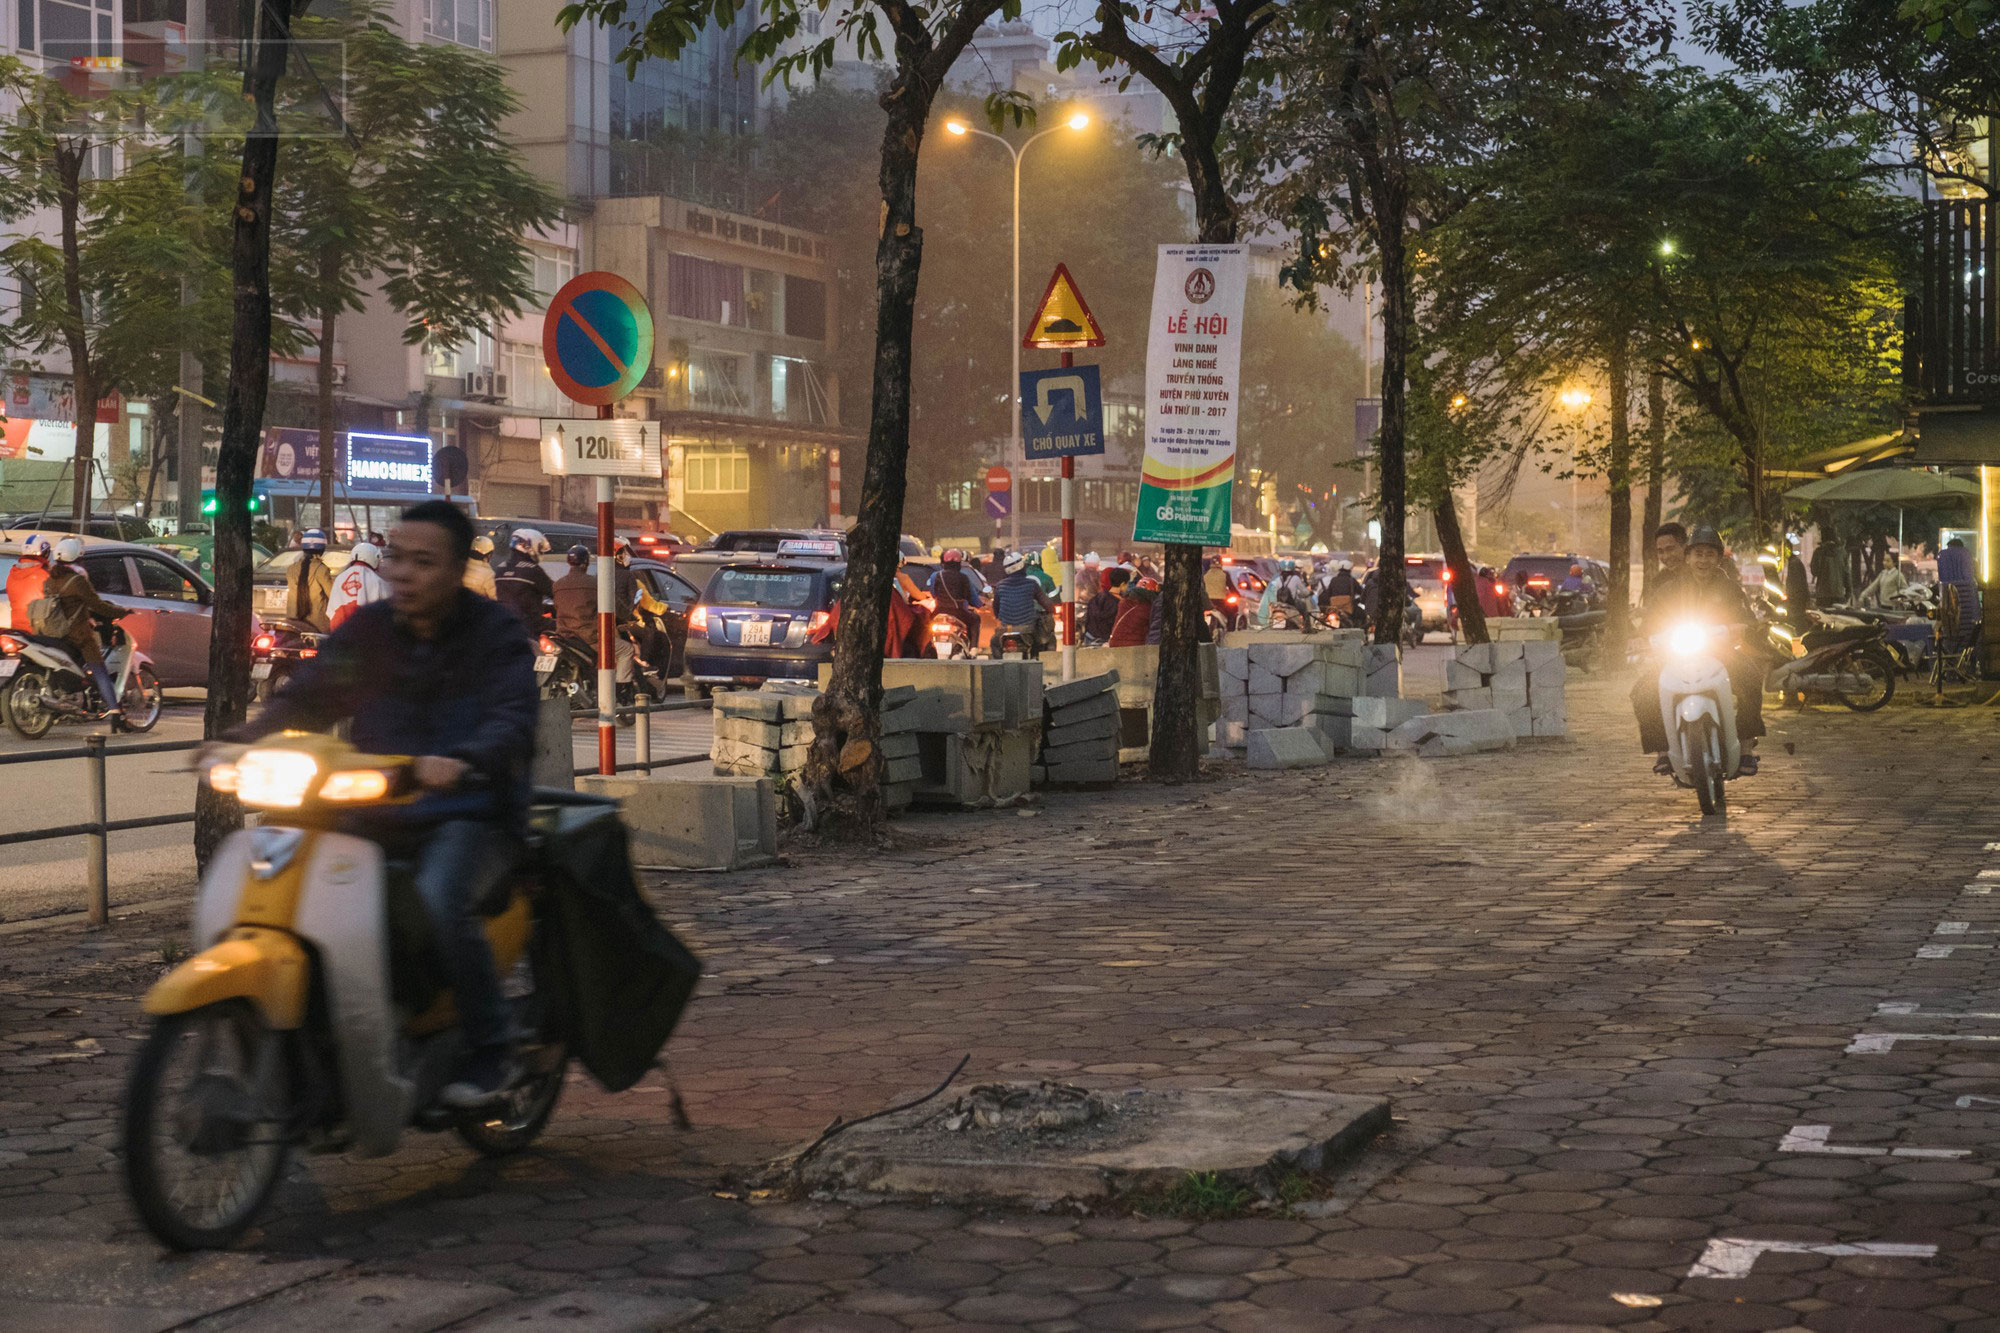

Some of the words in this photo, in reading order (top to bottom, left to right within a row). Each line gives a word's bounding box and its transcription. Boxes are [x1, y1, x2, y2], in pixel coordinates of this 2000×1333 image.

[1168, 309, 1188, 334] LỄ
[1194, 313, 1227, 339] HỘI
[1175, 343, 1193, 353] VINH
[1196, 344, 1218, 354] DANH
[1173, 357, 1193, 369] LÀNG
[1160, 388, 1182, 401] HUYỆN
[1203, 390, 1229, 401] XUYÊN
[1192, 406, 1200, 416] III
[1207, 407, 1227, 416] 2017
[1033, 432, 1053, 451] CHỖ
[1056, 433, 1081, 450] QUAY
[1083, 433, 1096, 446] XE
[352, 459, 429, 482] HANOSIMEX
[1156, 506, 1174, 521] G8
[1175, 512, 1210, 523] Platinum
[749, 625, 763, 633] 29A
